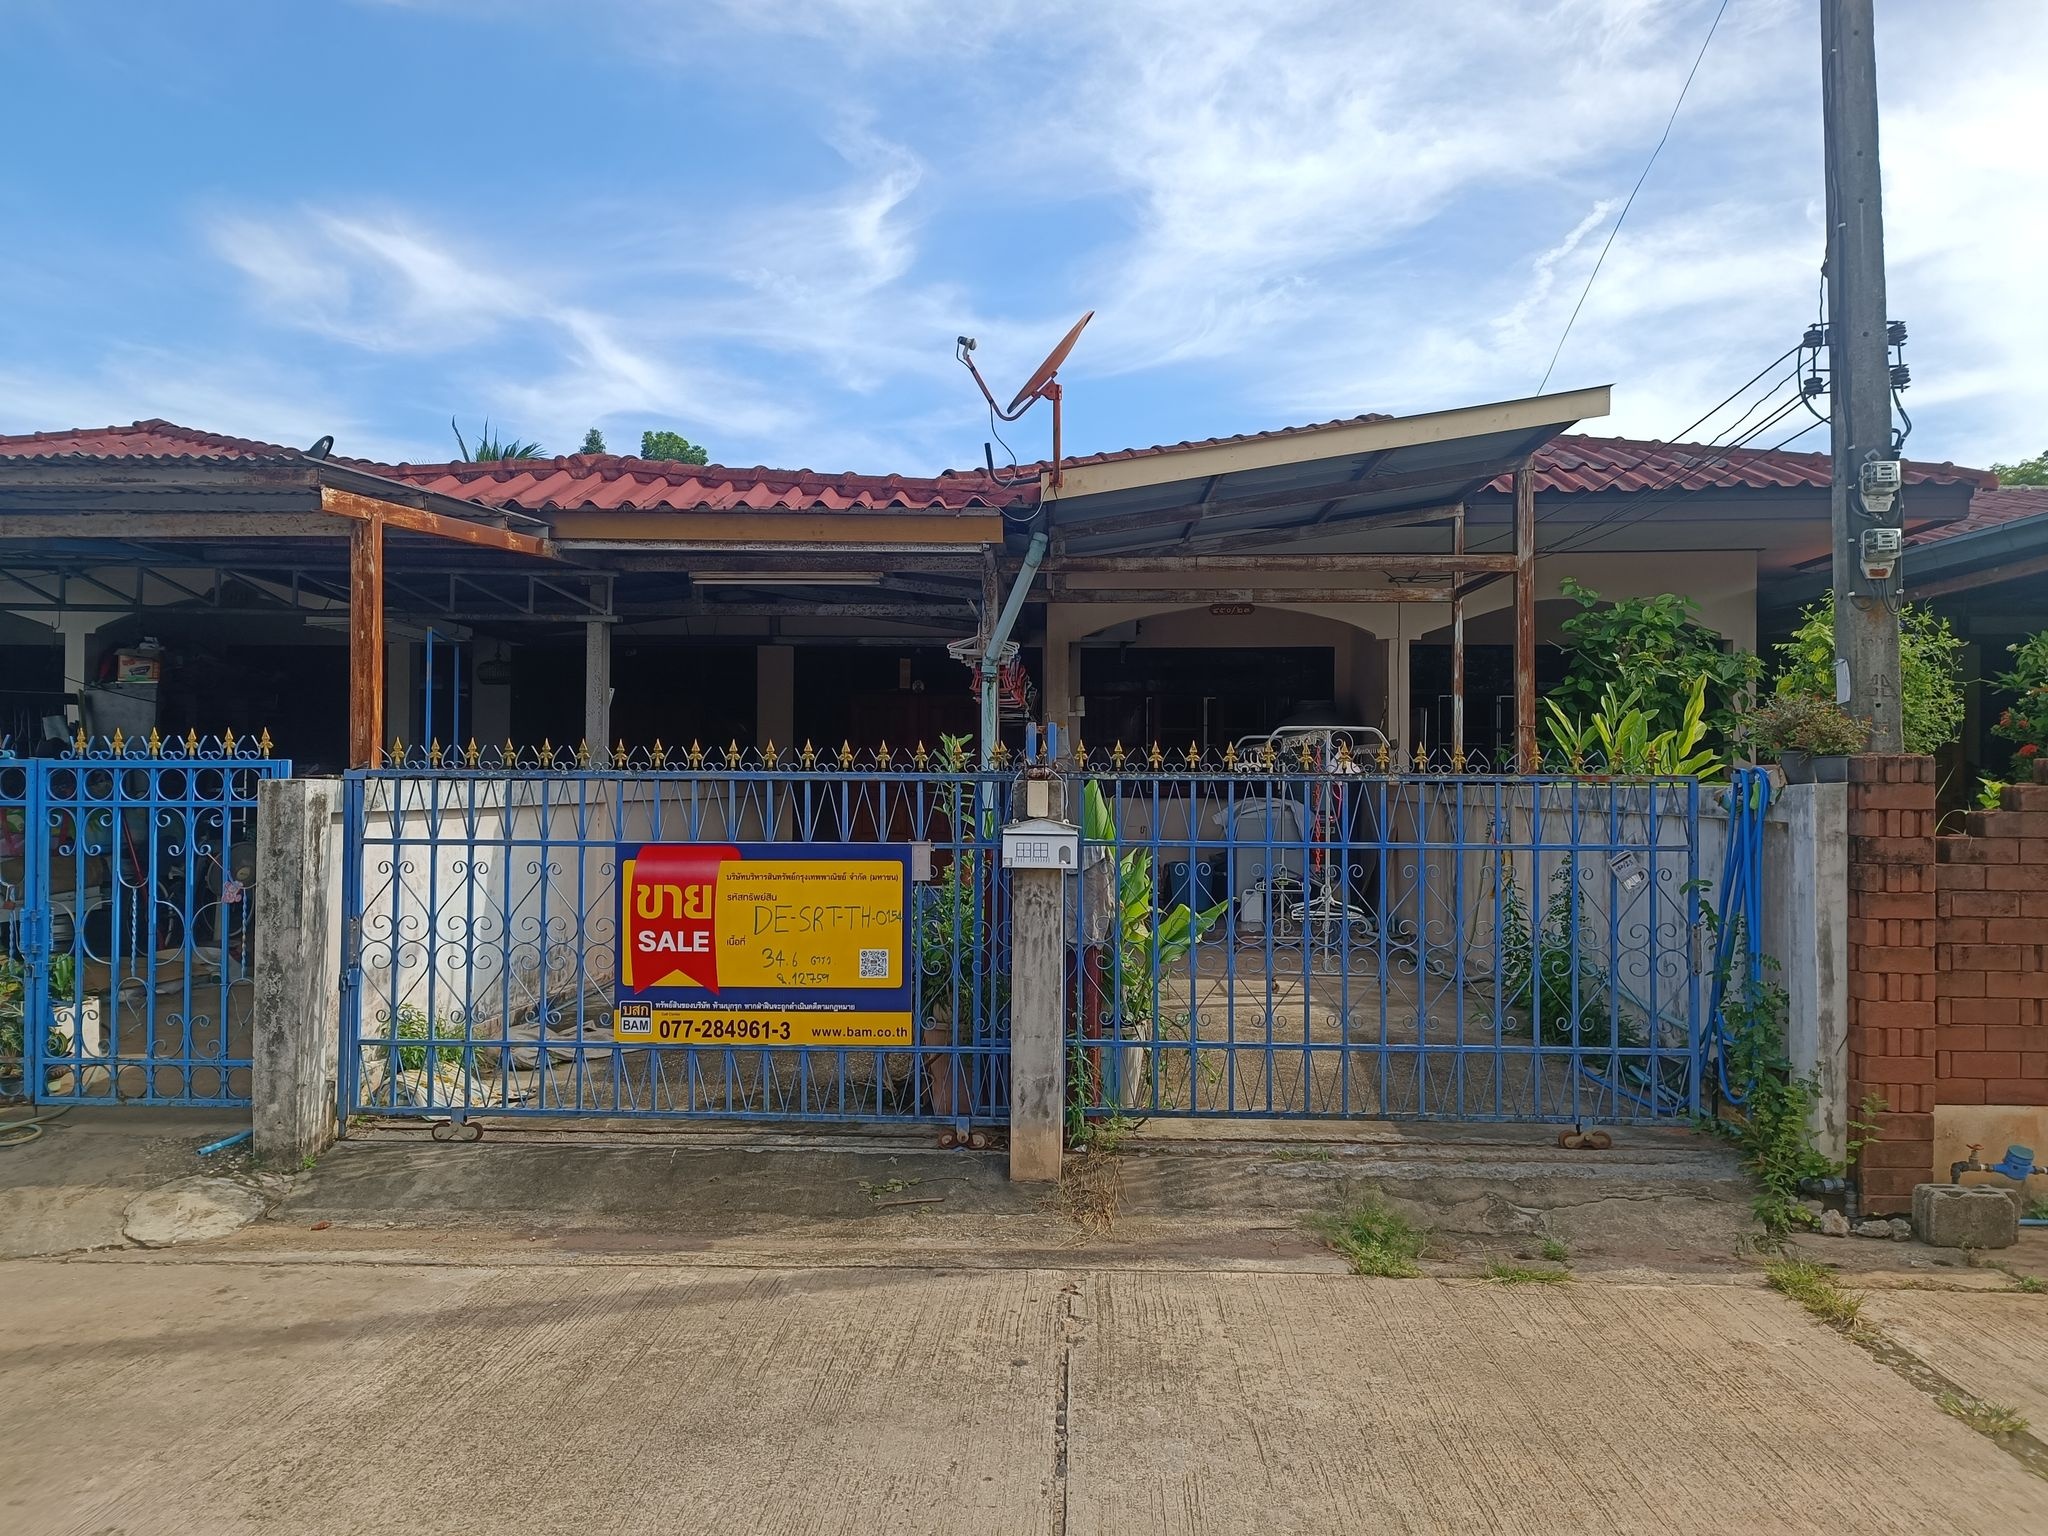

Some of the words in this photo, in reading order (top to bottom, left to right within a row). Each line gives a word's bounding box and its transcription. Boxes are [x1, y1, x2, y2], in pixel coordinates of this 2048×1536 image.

[726, 872, 847, 884] บริษัทบริหารสินทรัพย์กรุงเทพพาณิชย์
[849, 873, 867, 882] จำกัด
[869, 873, 899, 883] (มหาชน)
[637, 884, 713, 919] ขาย
[727, 891, 778, 902] รหัสทรัพย์สิน
[638, 930, 710, 953] SALE
[726, 934, 746, 946] เนื้อที่
[761, 947, 799, 969] 34.6
[622, 1004, 649, 1017] บสก
[623, 1020, 649, 1031] BAM
[659, 1019, 791, 1040] 077-284961-3
[811, 1026, 908, 1038] www.bam.co.th
